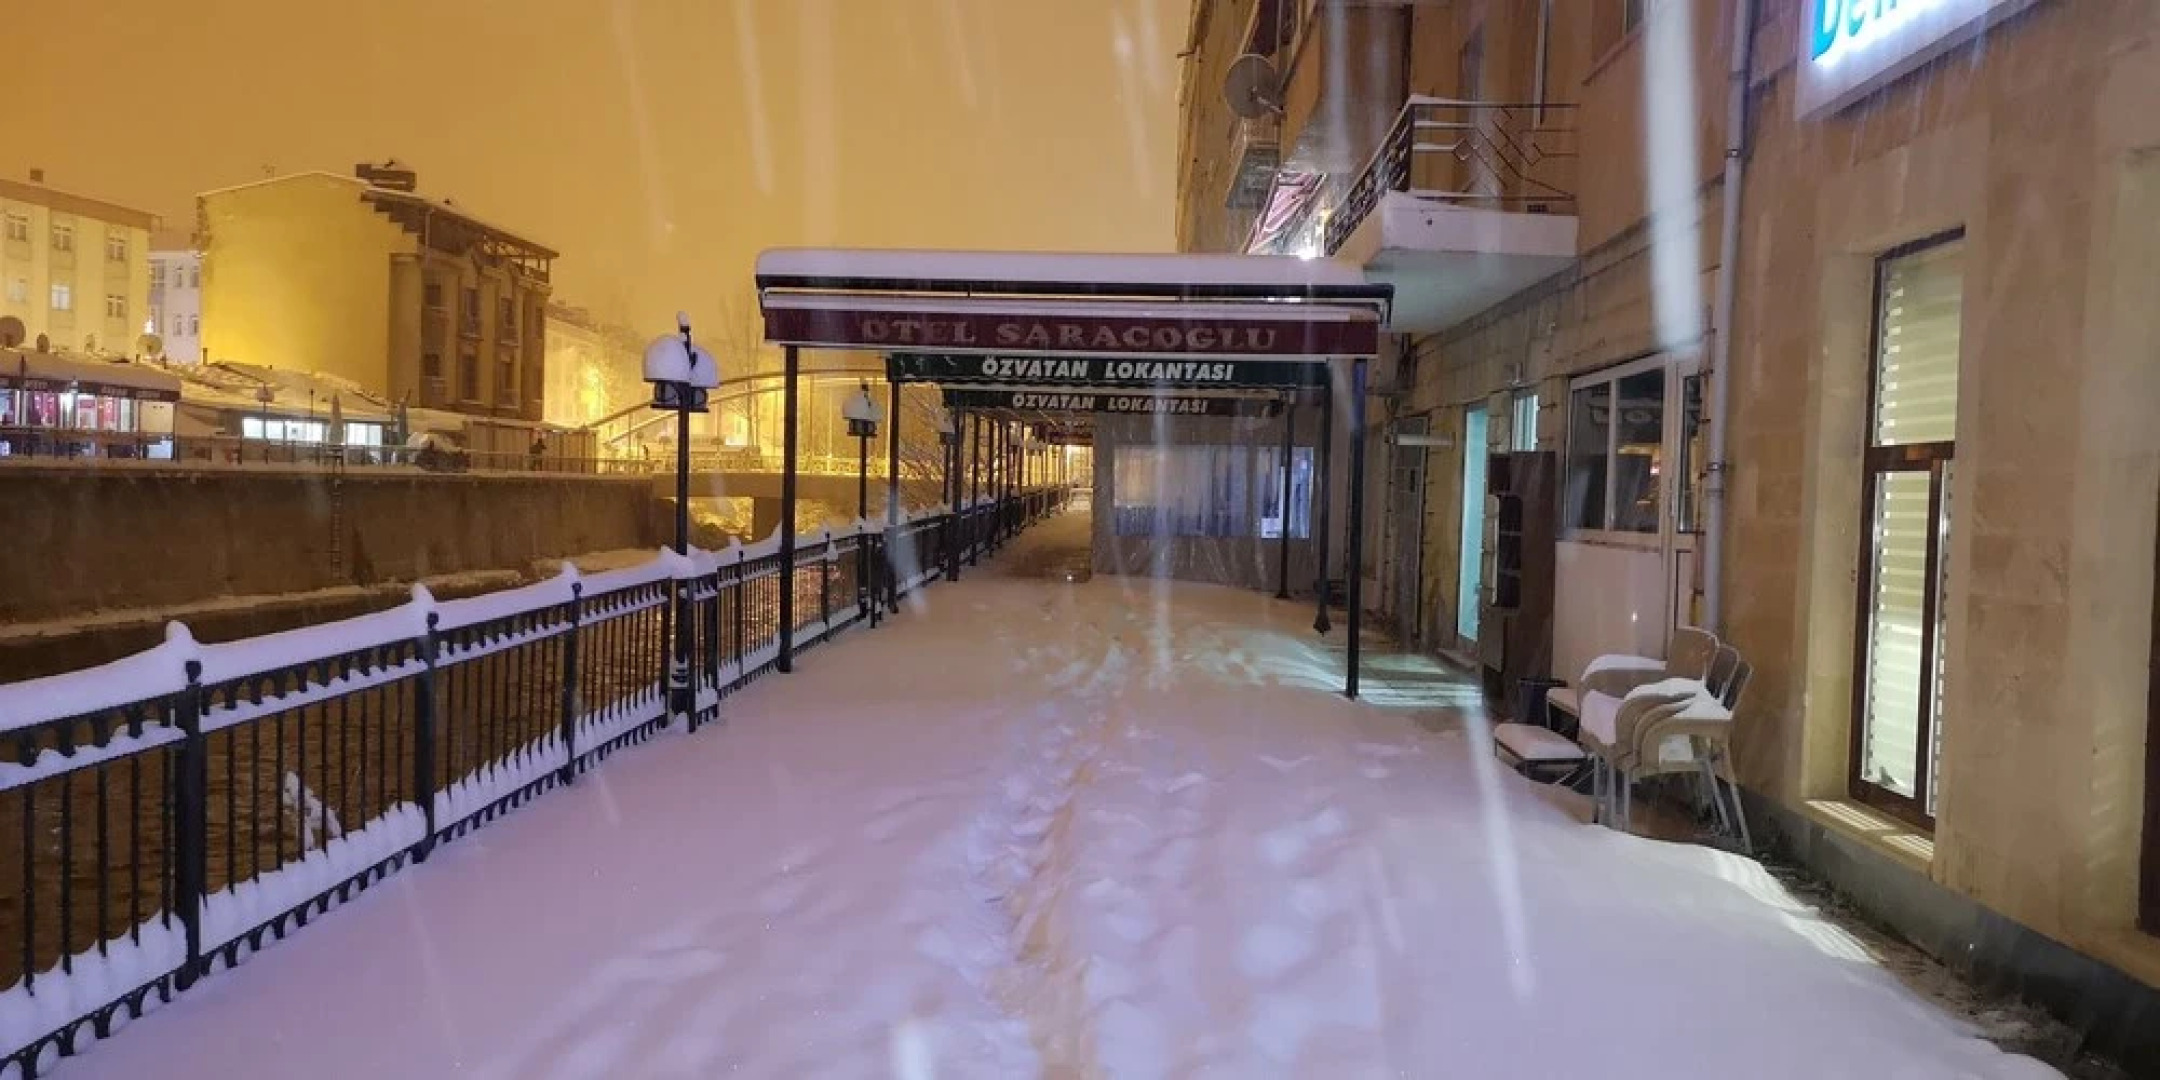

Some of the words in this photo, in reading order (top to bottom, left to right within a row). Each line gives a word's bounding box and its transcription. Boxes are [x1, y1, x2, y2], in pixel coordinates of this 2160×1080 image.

[862, 320, 976, 343] OTEL
[982, 355, 1089, 377] ÖZVATAN
[1105, 362, 1234, 381] LOKANTASI
[1107, 397, 1208, 414] LOKANTASI
